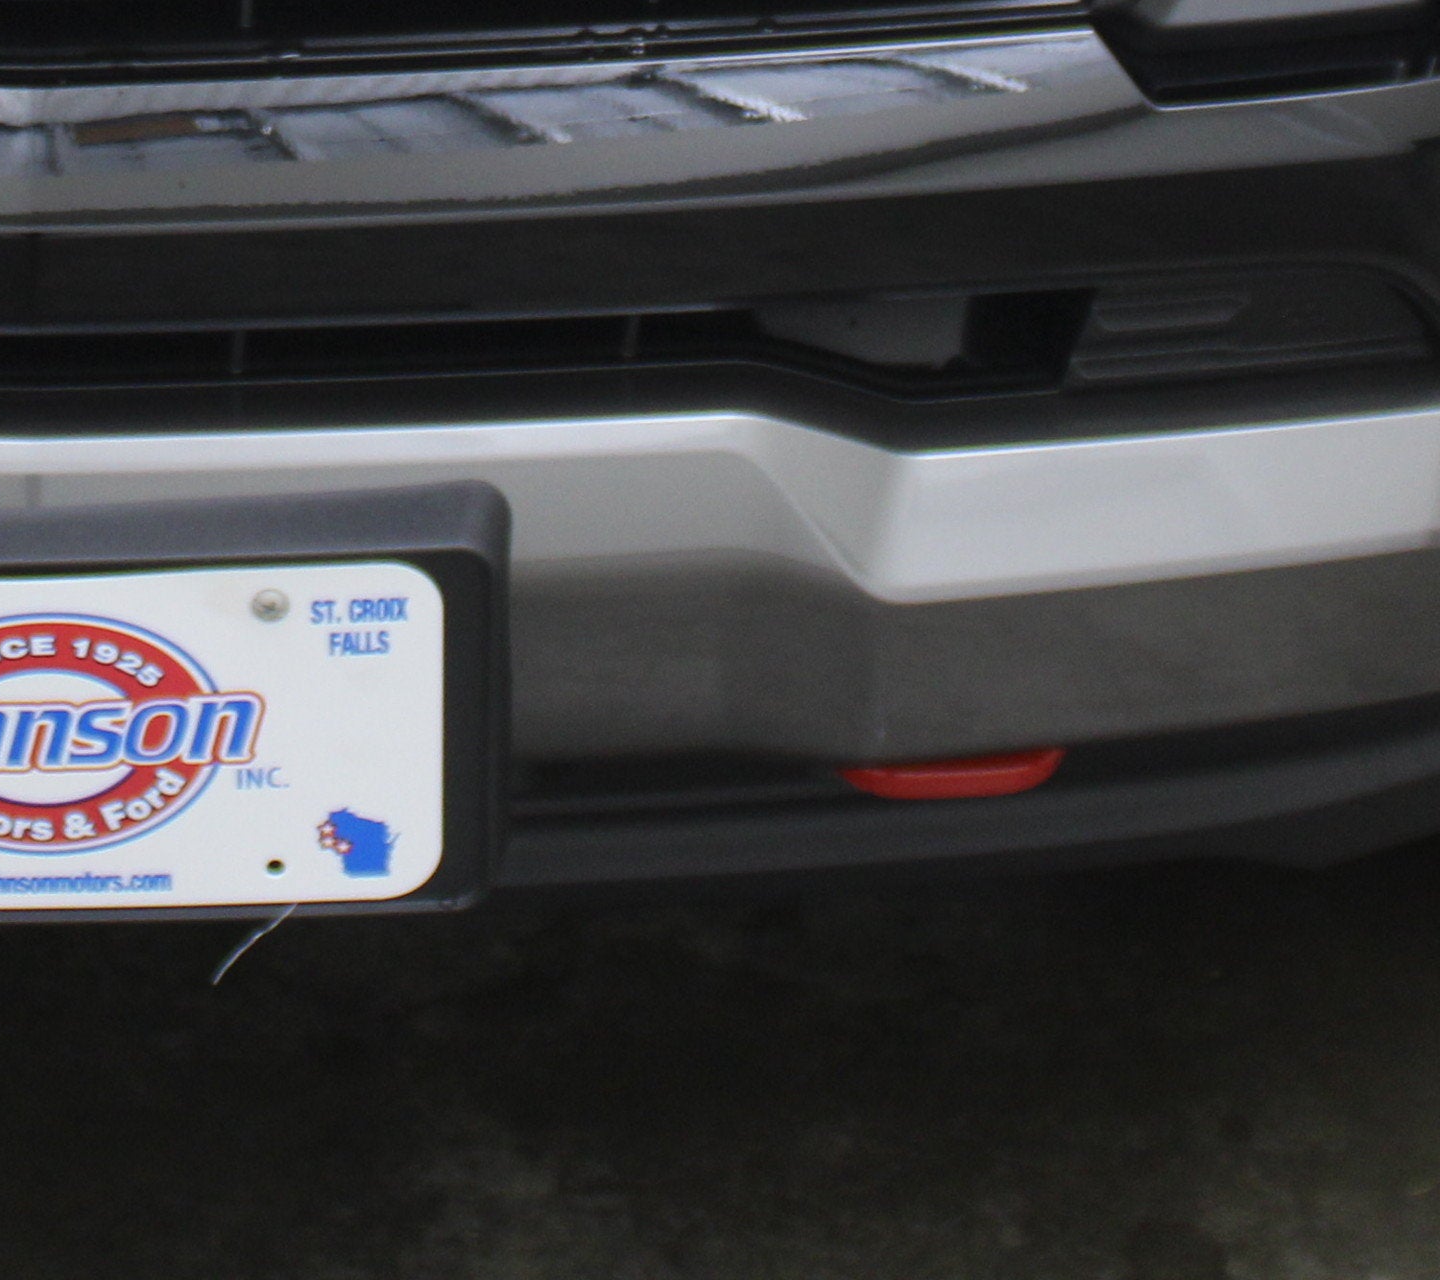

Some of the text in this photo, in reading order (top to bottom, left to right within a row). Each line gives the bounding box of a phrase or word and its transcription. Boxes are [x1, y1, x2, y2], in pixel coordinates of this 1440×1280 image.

[310, 597, 408, 624] ST. CROIX
[329, 630, 389, 655] FALLS
[71, 638, 165, 687] 1925
[235, 767, 290, 790] INC.
[62, 811, 97, 841] &
[100, 768, 188, 832] Ford
